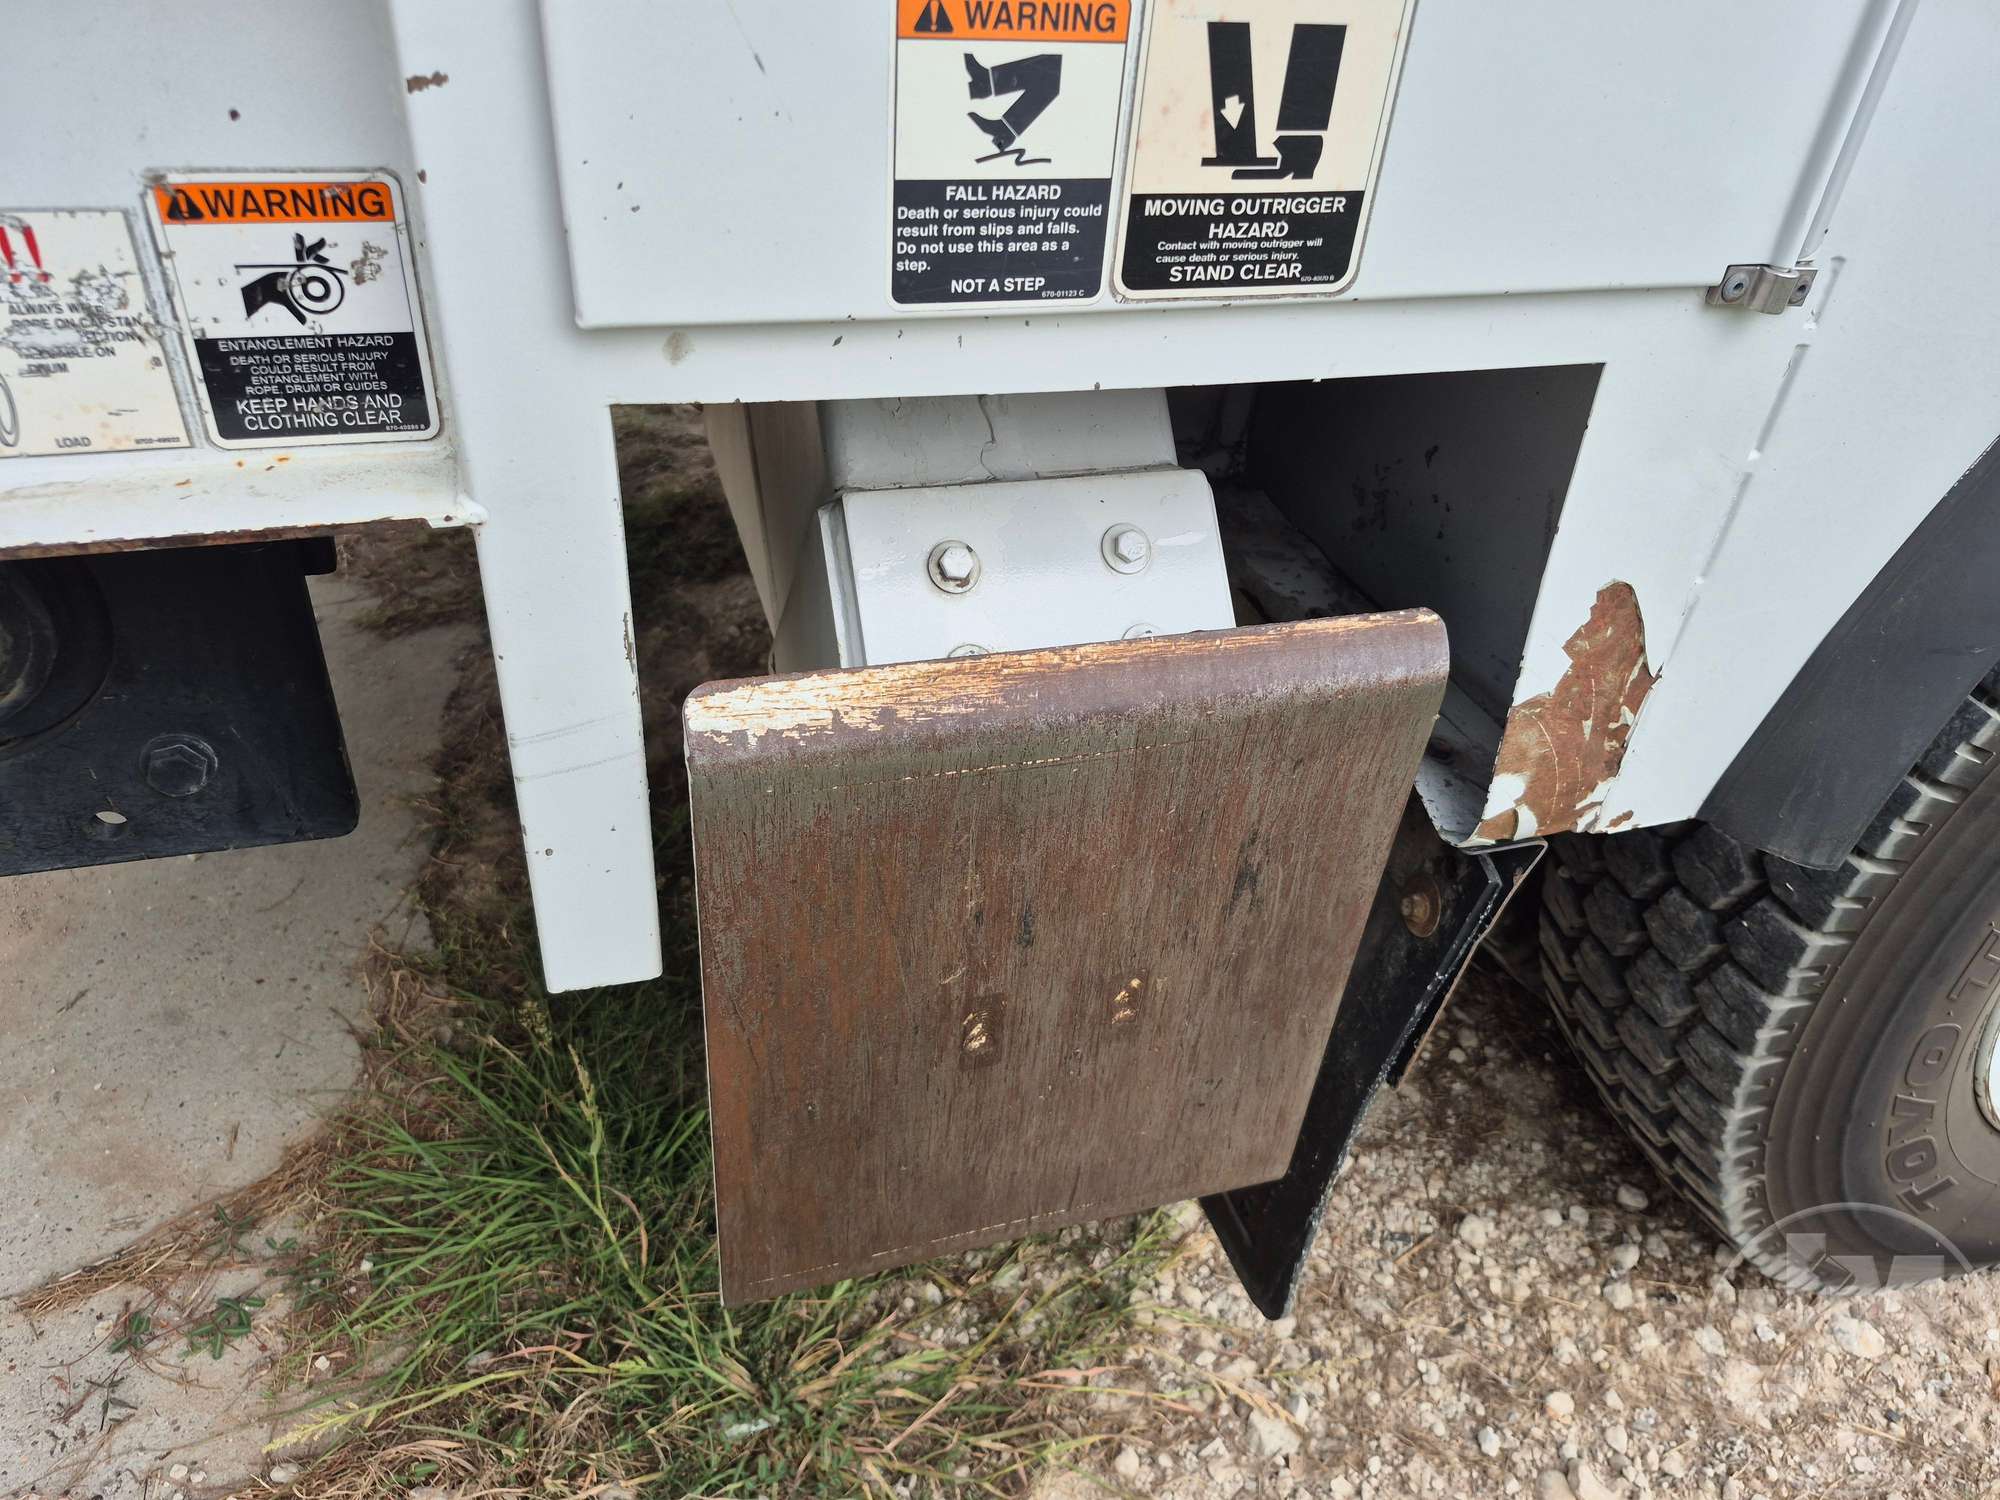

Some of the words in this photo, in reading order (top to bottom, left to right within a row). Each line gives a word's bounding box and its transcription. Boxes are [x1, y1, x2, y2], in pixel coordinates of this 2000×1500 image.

[965, 0, 1117, 33] WARNING
[946, 185, 988, 201] FALL
[992, 185, 1062, 200] HAZARD
[201, 187, 386, 219] WARNING
[1144, 199, 1225, 217] MOVING
[1230, 197, 1347, 215] OUTRIGGER
[897, 206, 939, 220] Death
[943, 209, 959, 219] or
[962, 205, 1016, 219] serious
[1020, 205, 1060, 220] injury
[1063, 204, 1103, 217] could
[897, 224, 938, 237] result
[943, 224, 976, 236] from
[979, 223, 1014, 238] slips
[1017, 222, 1043, 235] and
[1047, 222, 1080, 235] falls.
[1208, 221, 1289, 239] HAZARD
[896, 241, 916, 254] Do
[921, 242, 944, 254] not
[948, 243, 974, 254] use
[977, 240, 1004, 253] this
[1007, 241, 1038, 252] area
[1041, 241, 1058, 251] as
[1061, 240, 1070, 250] a
[1157, 241, 1197, 251] Contact
[1199, 240, 1220, 250] with
[1222, 239, 1258, 251] moving
[1260, 239, 1303, 251] outrigger
[1306, 238, 1323, 247] will
[1155, 255, 1186, 264] cause
[1189, 252, 1217, 262] death
[1219, 253, 1229, 261] or
[1232, 252, 1269, 261] serious
[1271, 251, 1300, 263] injury.
[896, 260, 931, 273] step.
[1169, 265, 1235, 282] STAND
[1240, 263, 1303, 280] CLEAR
[951, 279, 986, 294] NOT
[988, 278, 1001, 293] A
[1004, 277, 1046, 292] STEP
[54, 318, 78, 330] ON
[218, 337, 333, 351] ENTANGLEMENT
[338, 335, 394, 347] HAZARD
[96, 347, 116, 358] ON
[230, 355, 270, 366] DEATH
[272, 354, 290, 364] OR
[293, 353, 346, 363] SERIOUS
[348, 352, 388, 362] INJURY
[251, 364, 292, 375] COULD
[294, 363, 338, 373] RESULT
[342, 362, 376, 372] FROM
[252, 374, 346, 385] ENTANGLEMENT
[348, 372, 378, 381] WITH
[286, 383, 321, 394] DRUM
[324, 382, 341, 392] OR
[344, 381, 388, 391] GUIDES
[237, 398, 288, 415] KEEP
[293, 395, 359, 412] HANDS
[364, 393, 402, 409] AND
[244, 413, 339, 430] CLOTHING
[342, 410, 403, 426] CLEAR
[55, 437, 91, 448] LOAD
[1886, 1022, 1961, 1216] TOYO
